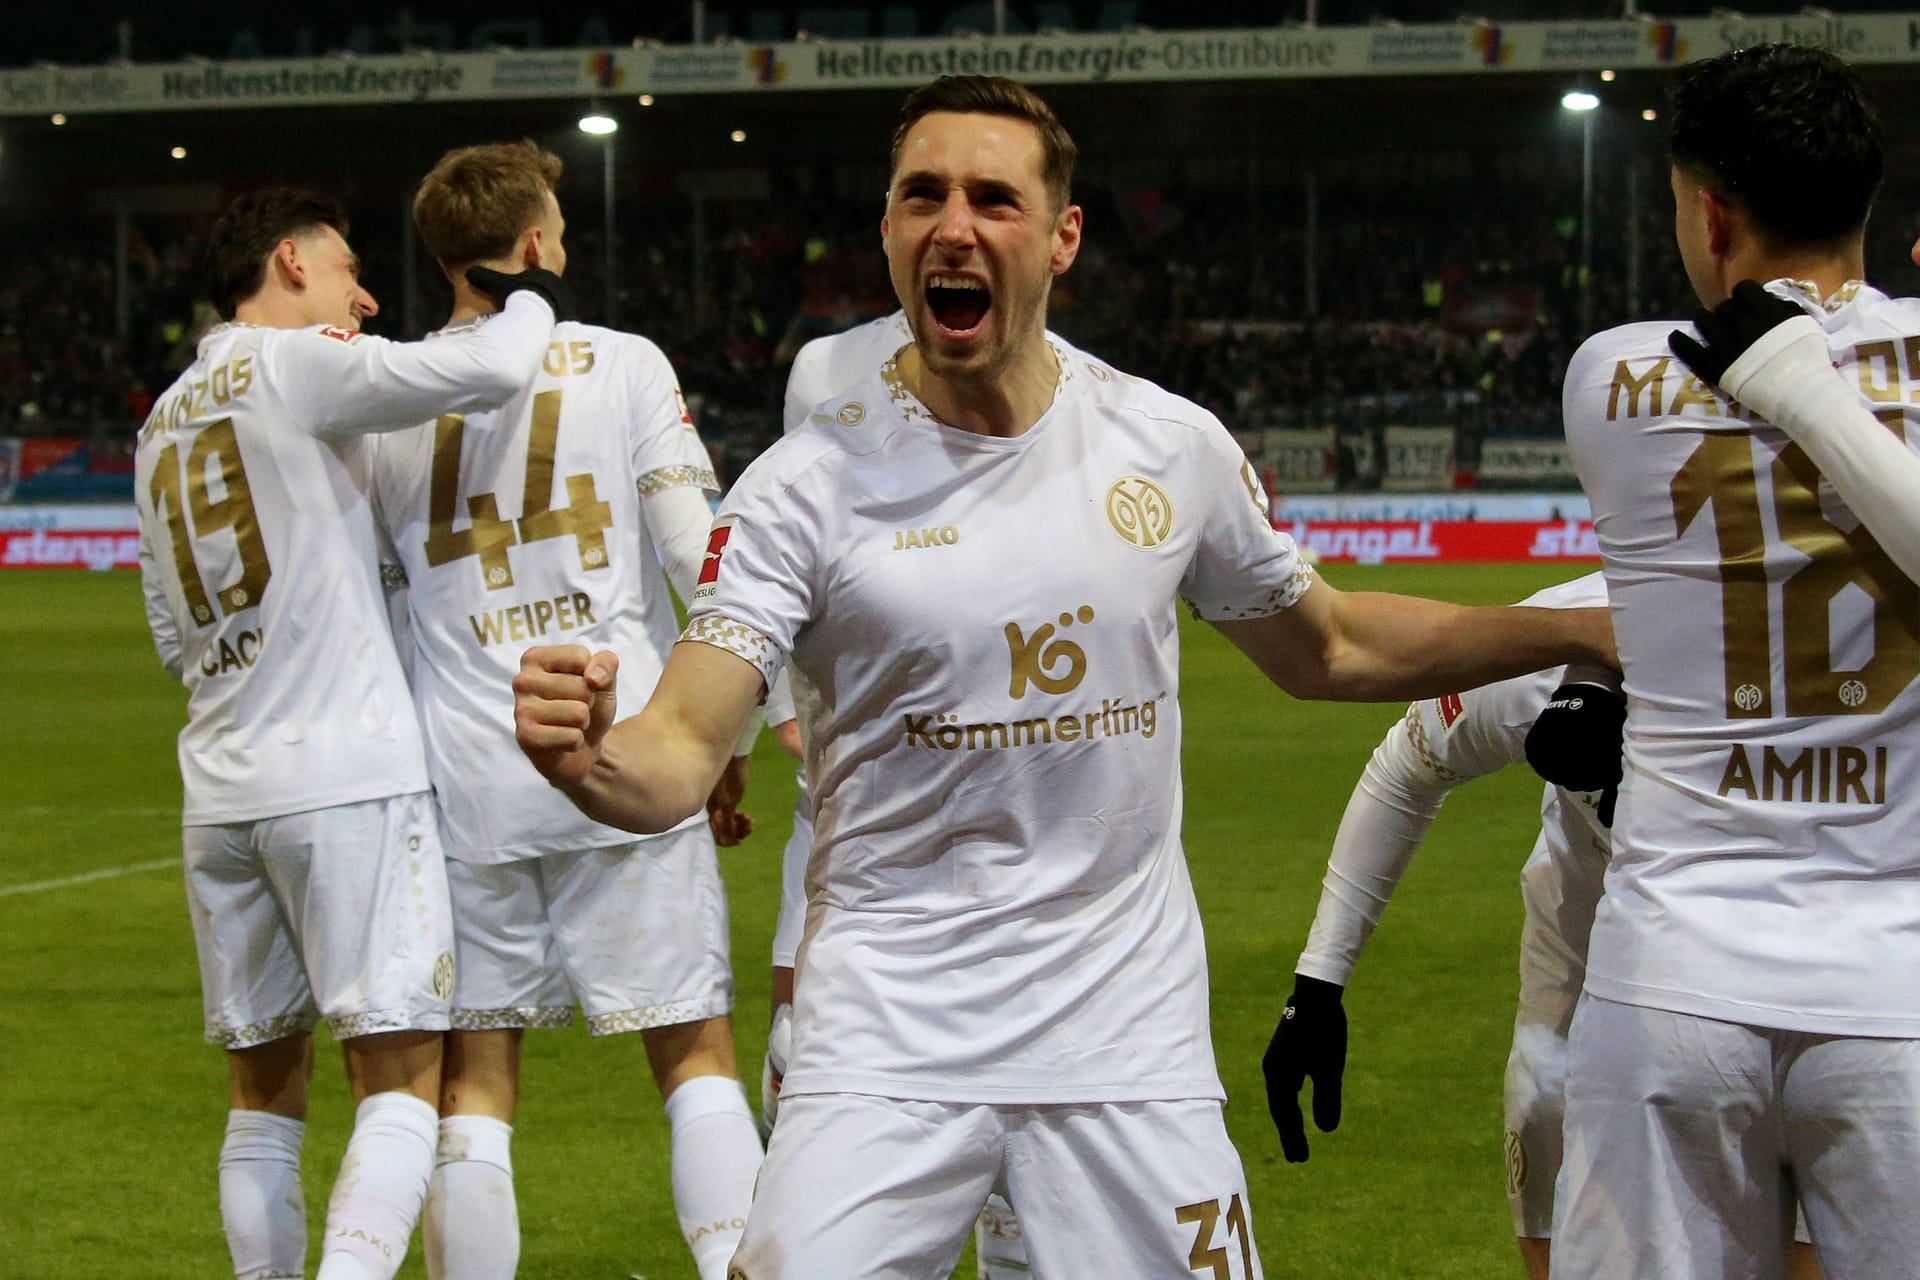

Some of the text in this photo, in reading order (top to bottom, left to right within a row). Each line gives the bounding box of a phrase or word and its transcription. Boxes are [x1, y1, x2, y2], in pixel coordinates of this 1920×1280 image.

[541, 341, 595, 377] 05
[423, 388, 614, 592] 44
[150, 417, 272, 629] 19
[893, 524, 960, 552] JAKO
[1670, 409, 1920, 720] 18
[469, 591, 597, 648] WEIPER
[903, 695, 1158, 751] Kömmerling
[1717, 743, 1887, 805] AMIRI
[1174, 1193, 1254, 1280] 31
